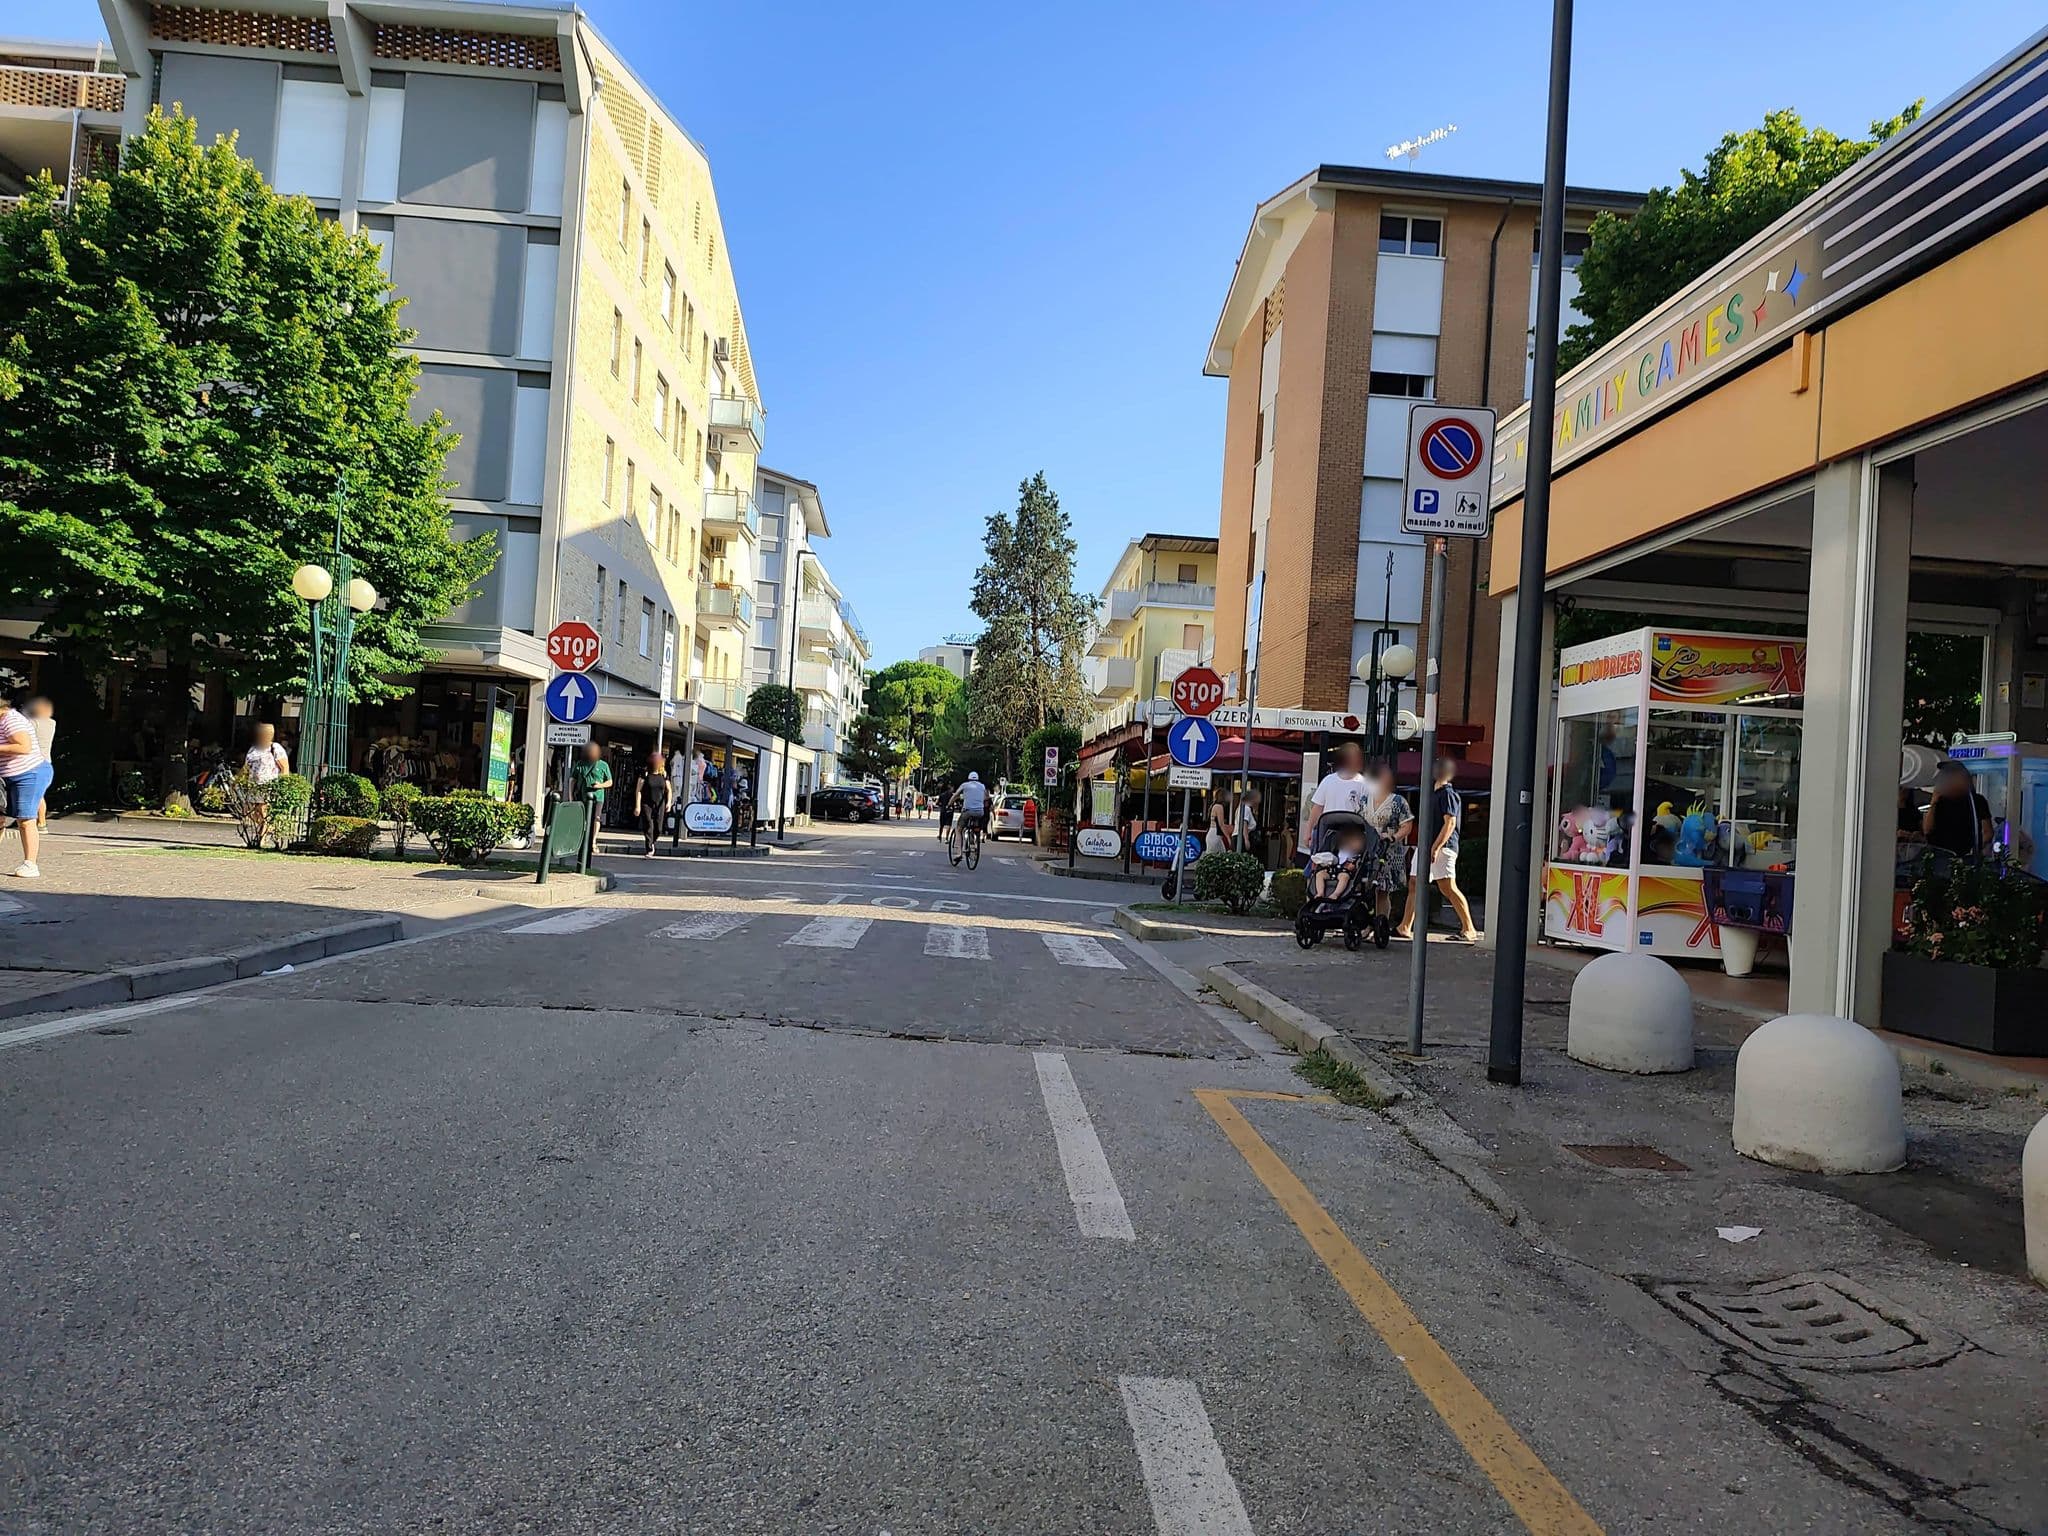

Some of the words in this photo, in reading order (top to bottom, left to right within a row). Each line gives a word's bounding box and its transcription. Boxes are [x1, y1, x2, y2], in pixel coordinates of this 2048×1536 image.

[1639, 292, 1745, 398] GAMES
[1419, 491, 1435, 512] P
[1407, 518, 1442, 528] massimo
[1444, 519, 1455, 529] 30
[1457, 520, 1485, 531] minuti
[550, 636, 598, 657] STOP
[1603, 649, 1643, 681] PRIZES
[1658, 645, 1778, 681] Cosmic
[1177, 681, 1222, 703] STOP
[1208, 710, 1262, 724] IZZERA
[1284, 716, 1327, 728] RISTORANTE
[1140, 845, 1195, 859] THERME
[1565, 871, 1606, 937] XL
